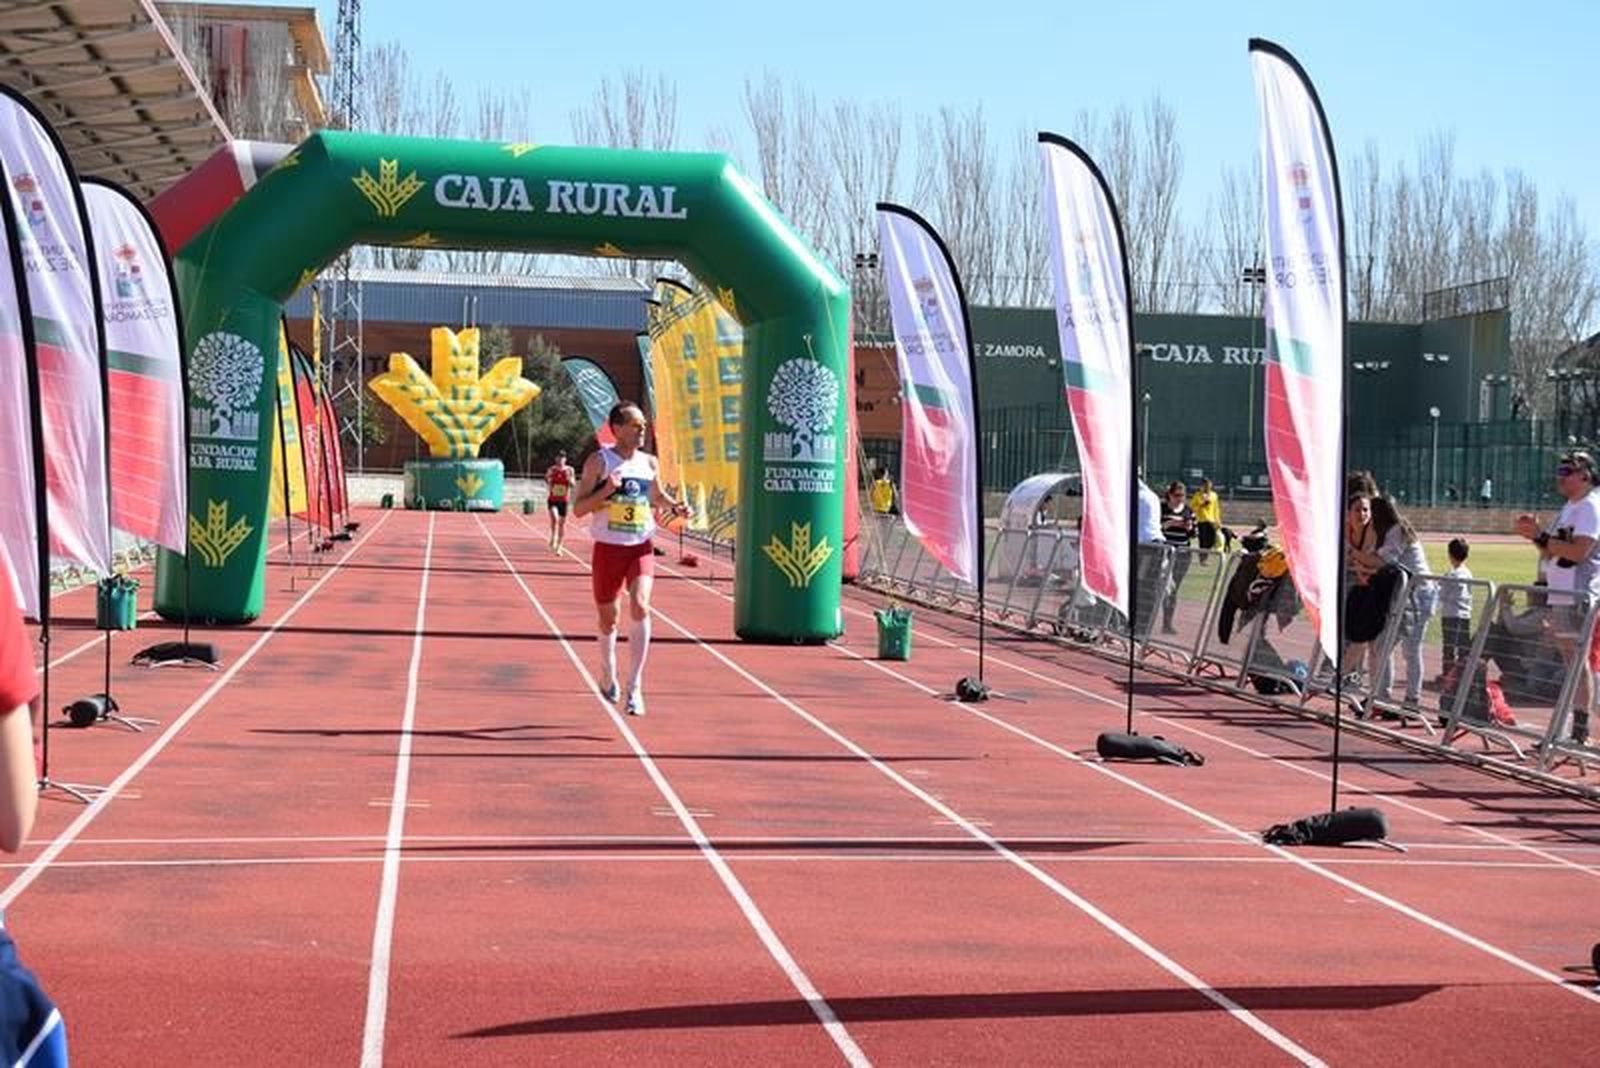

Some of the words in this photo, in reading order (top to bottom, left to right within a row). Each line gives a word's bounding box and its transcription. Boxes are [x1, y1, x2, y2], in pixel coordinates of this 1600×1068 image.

[434, 174, 534, 211] CAJA
[546, 180, 687, 219] RURAL
[984, 344, 1045, 358] ZAMORA
[1152, 343, 1214, 364] CAJA
[189, 443, 258, 458] UNDACION
[189, 455, 214, 468] AJA
[764, 467, 834, 481] FUNDACION
[763, 479, 796, 492] CAJA
[798, 480, 834, 494] RURAL
[623, 506, 635, 522] 3
